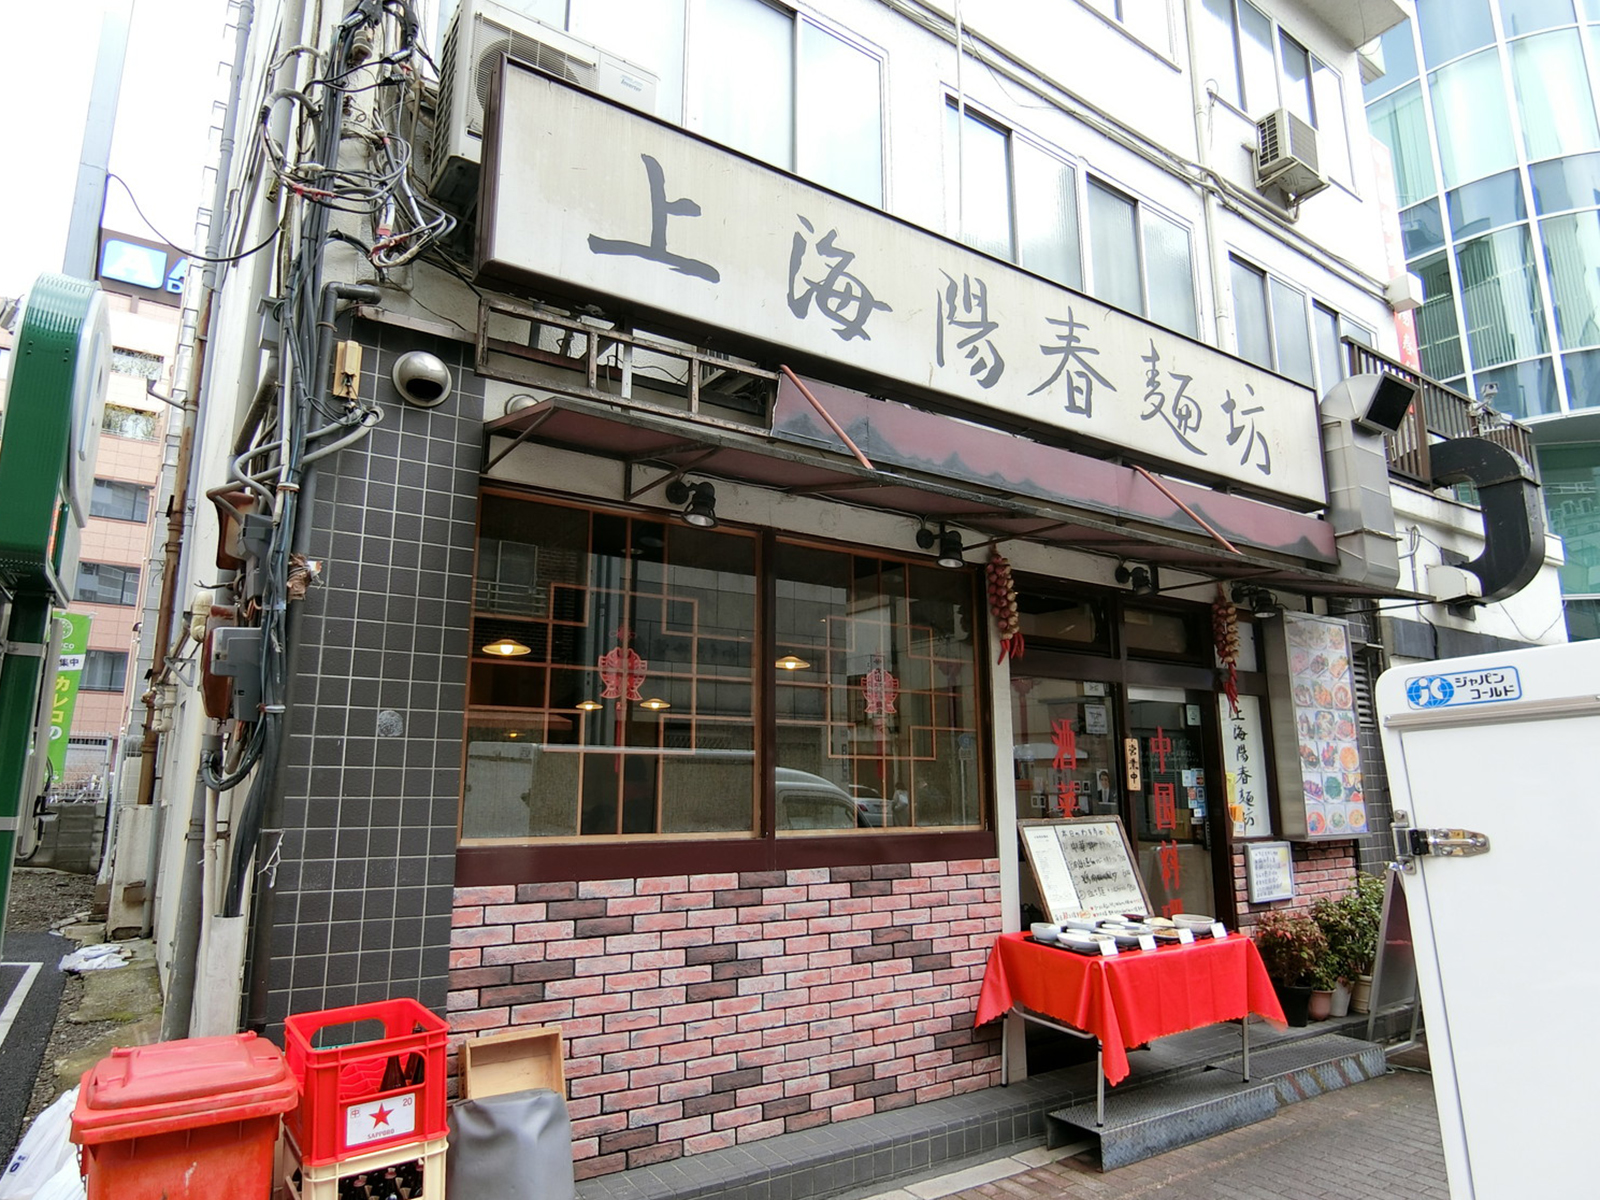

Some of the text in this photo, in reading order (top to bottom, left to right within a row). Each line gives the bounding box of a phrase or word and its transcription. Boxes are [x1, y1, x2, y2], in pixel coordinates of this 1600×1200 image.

[1455, 672, 1504, 688] ジャパン
[1470, 685, 1514, 700] コールド
[1128, 744, 1139, 783] 営業中
[402, 1097, 413, 1107] 20
[368, 1129, 394, 1139] SAPPORO
